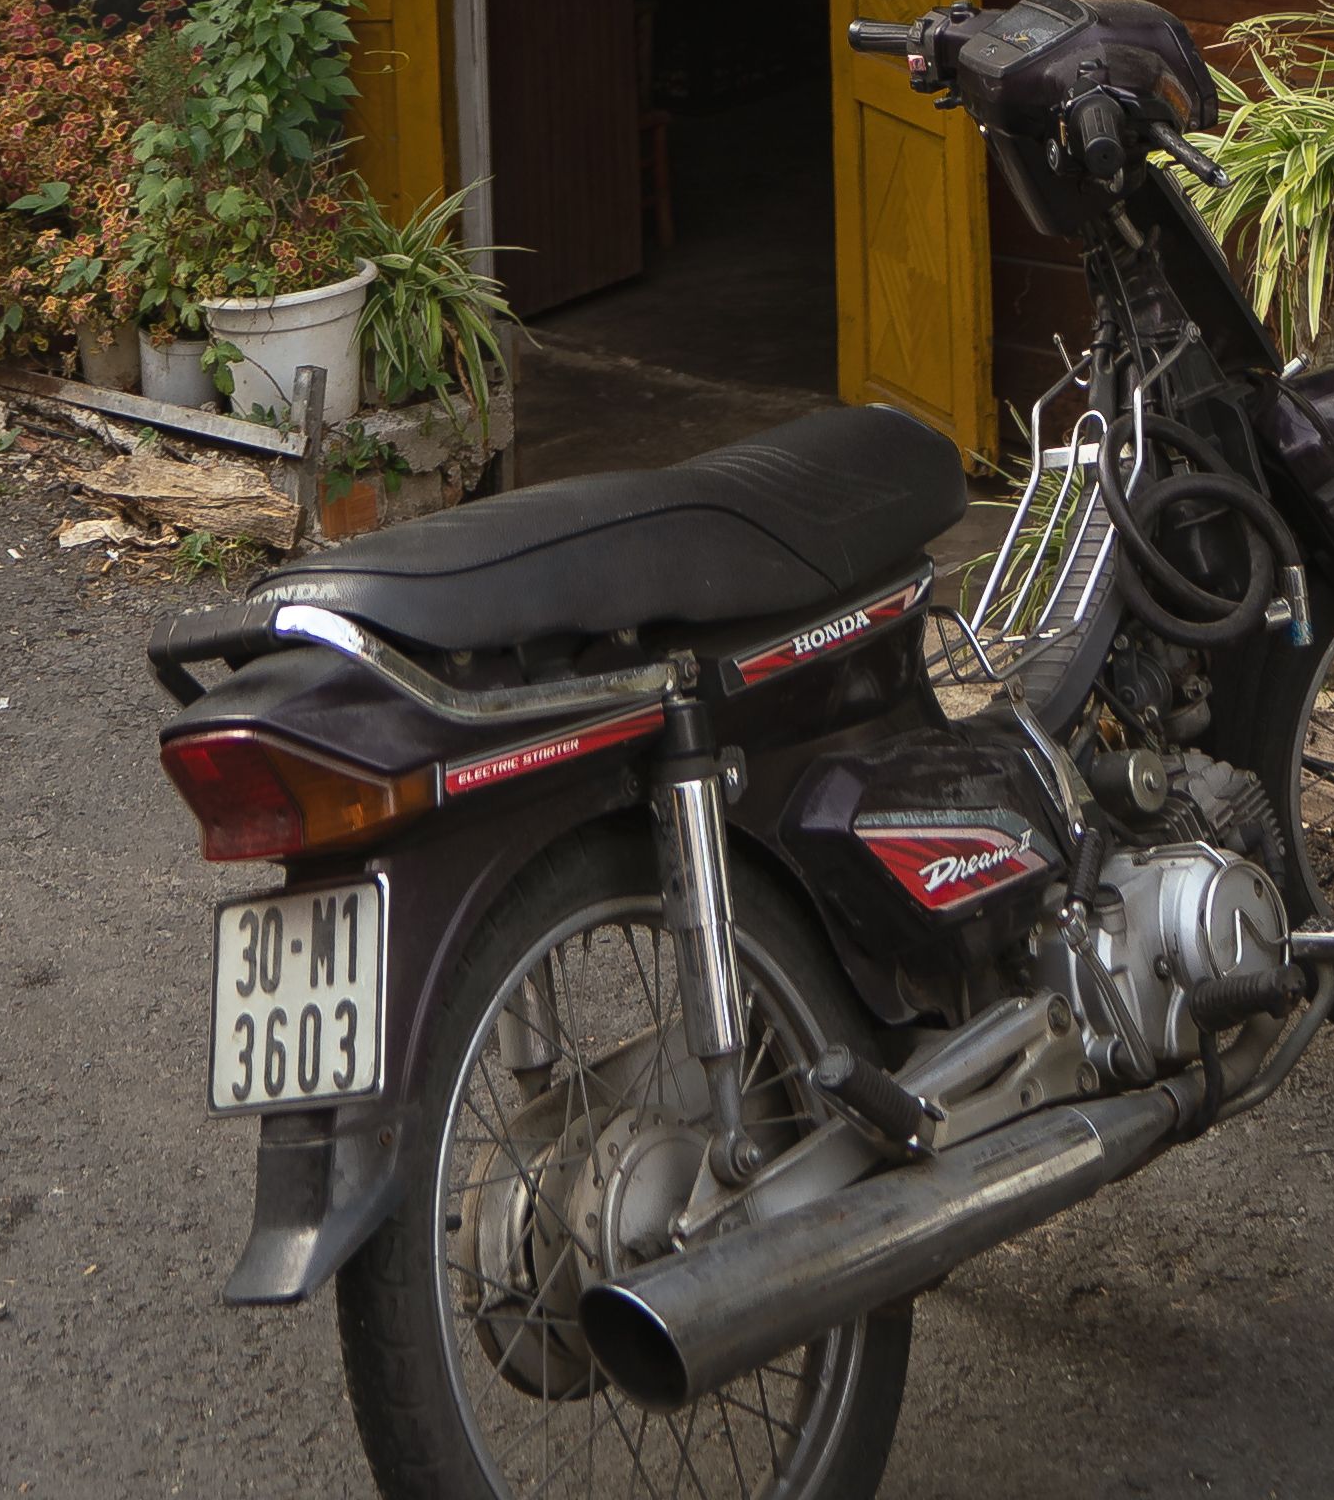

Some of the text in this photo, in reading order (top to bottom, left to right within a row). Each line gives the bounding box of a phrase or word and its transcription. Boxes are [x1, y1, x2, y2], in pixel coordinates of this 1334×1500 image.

[792, 609, 871, 656] HONDA
[458, 738, 580, 786] ELECTRIC STARTER
[918, 845, 1016, 893] Dream
[235, 892, 359, 997] 30-M1
[231, 997, 358, 1102] 3603
